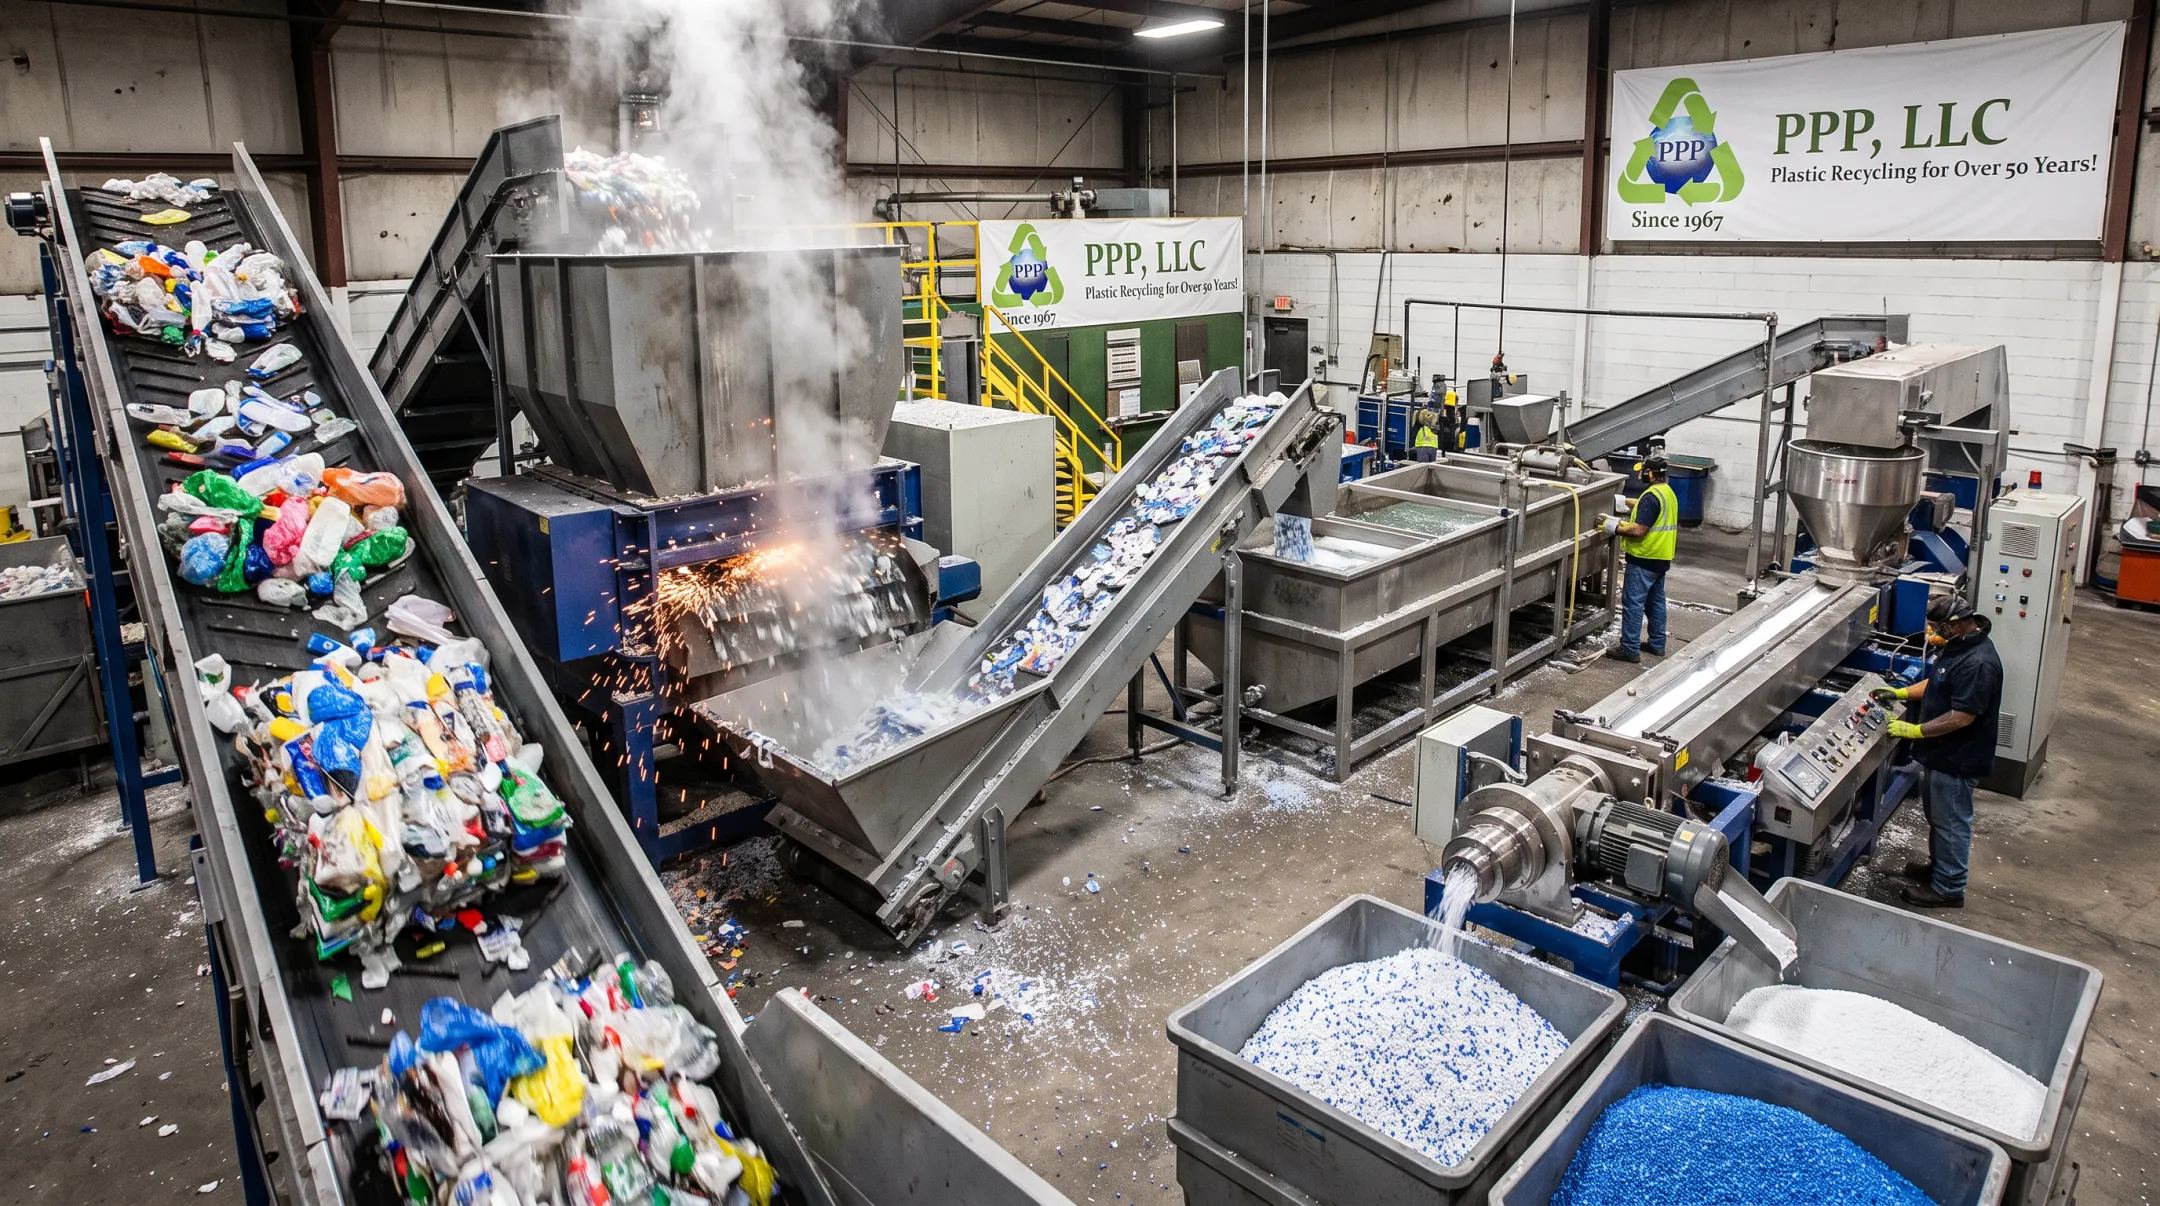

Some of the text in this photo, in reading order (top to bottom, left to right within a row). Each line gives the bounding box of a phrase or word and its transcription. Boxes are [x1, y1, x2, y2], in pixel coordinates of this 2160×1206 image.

[1773, 98, 2011, 159] PPP, LLC
[1658, 140, 1705, 162] PPP
[1771, 154, 2098, 185] Plastic Recycling for Over 50 Years!
[1631, 210, 1724, 233] Since 1967
[1014, 263, 1043, 278] PPP
[1084, 240, 1206, 280] PPP, LLC
[1085, 277, 1238, 300] Plastic Recycling for Over 50 Years!
[1033, 309, 1056, 327] 1967
